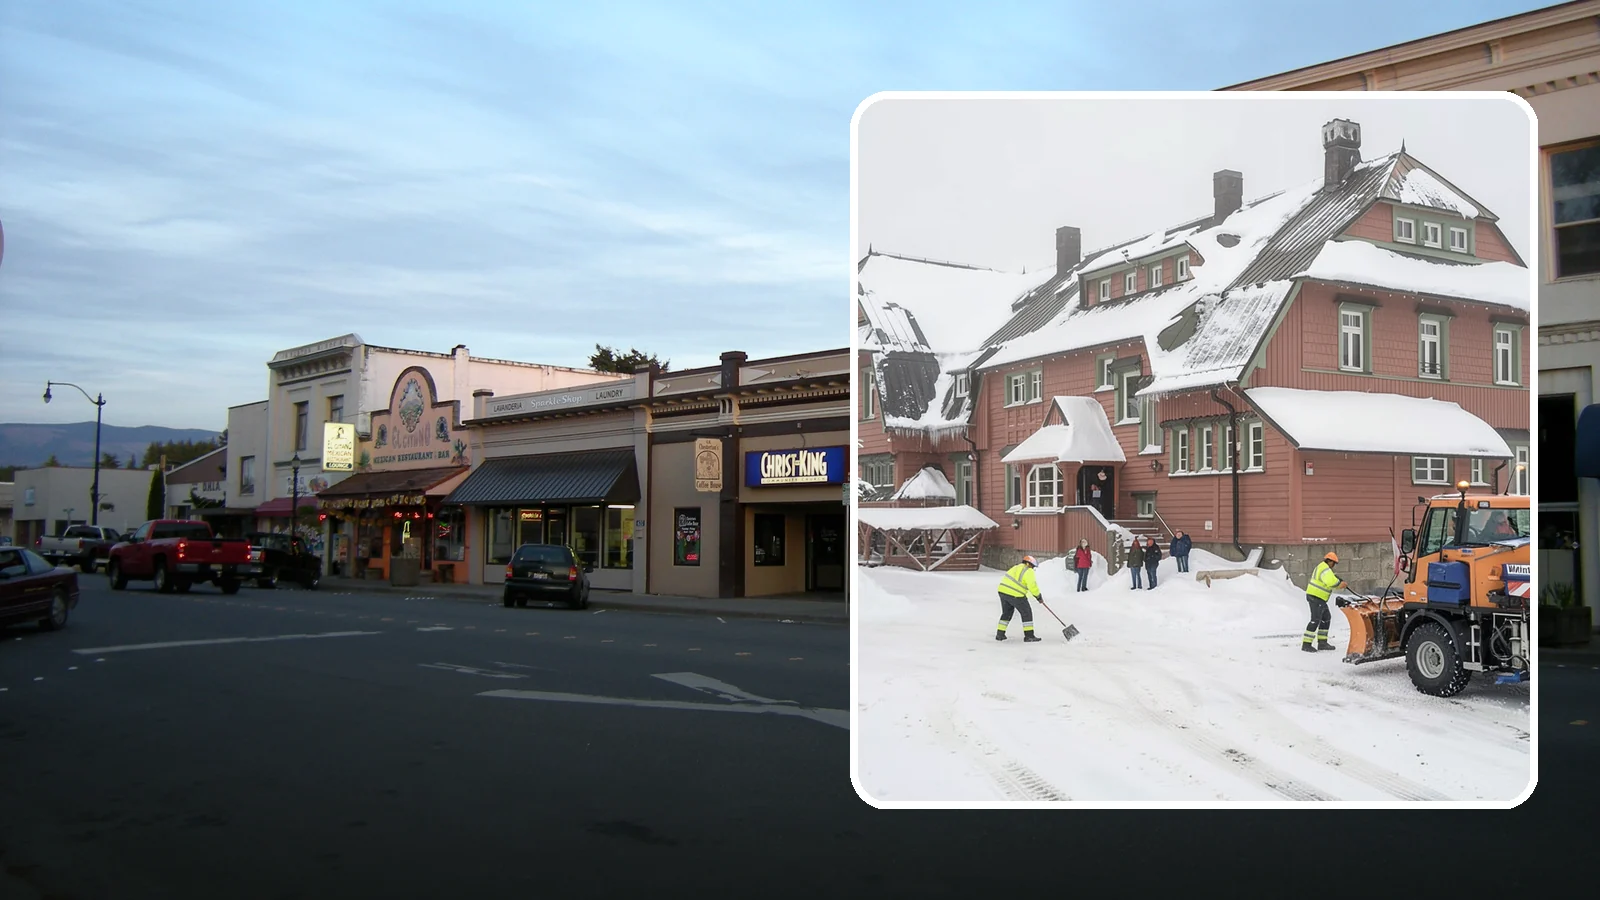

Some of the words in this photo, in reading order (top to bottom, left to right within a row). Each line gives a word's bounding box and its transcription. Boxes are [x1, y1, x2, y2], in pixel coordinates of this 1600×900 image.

[595, 389, 623, 400] LAUNDRY
[493, 402, 522, 412] LAVANDERIA
[531, 396, 561, 409] Sparkle
[561, 395, 582, 405] Shop
[373, 456, 396, 464] MEXICAN
[398, 452, 433, 462] RESTAURANT
[438, 450, 450, 459] BAR
[761, 452, 797, 478] CHRIST
[799, 450, 827, 476] KING
